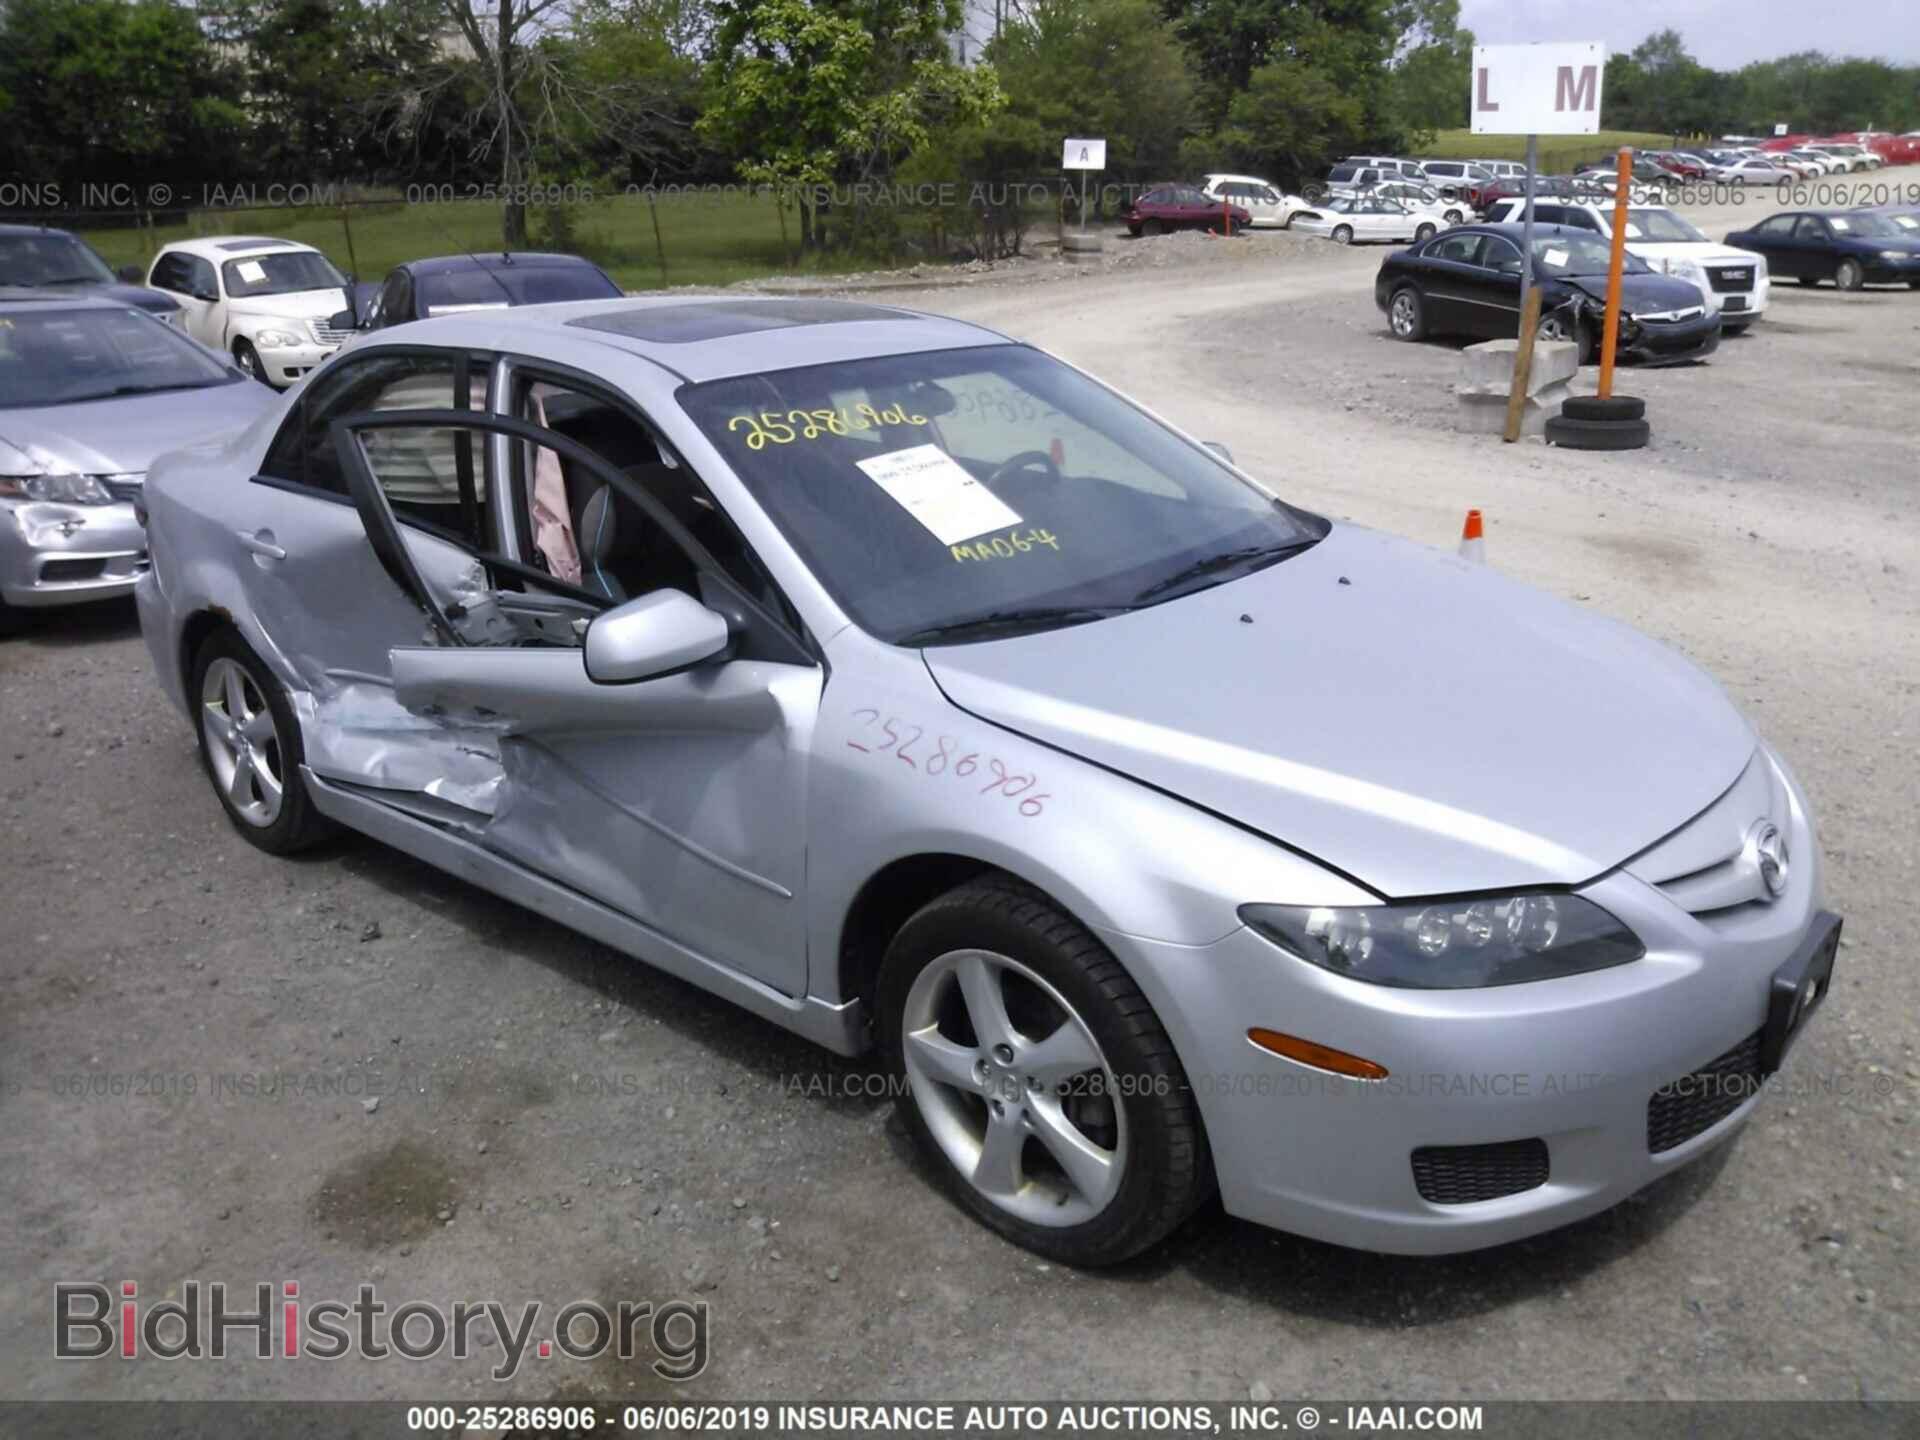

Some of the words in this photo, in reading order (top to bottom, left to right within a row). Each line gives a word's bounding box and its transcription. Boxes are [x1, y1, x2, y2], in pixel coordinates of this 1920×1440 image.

[1477, 67, 1500, 112] L
[1554, 65, 1598, 112] M
[1079, 146, 1089, 162] A
[728, 402, 928, 450] 25286906
